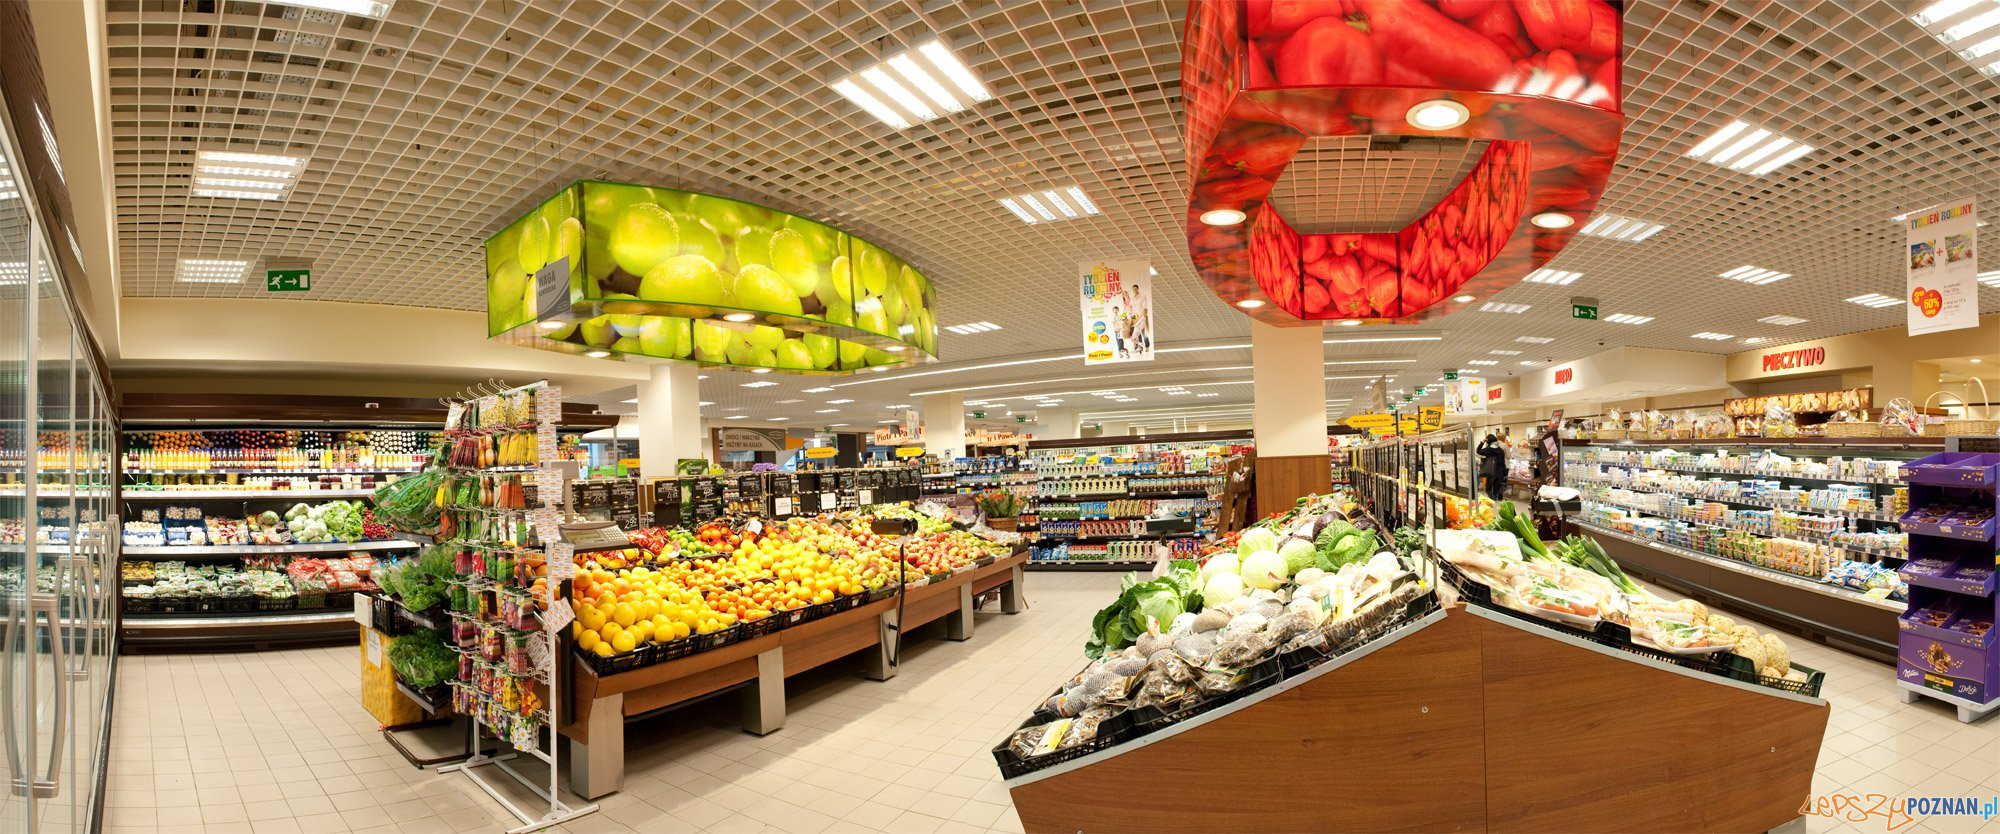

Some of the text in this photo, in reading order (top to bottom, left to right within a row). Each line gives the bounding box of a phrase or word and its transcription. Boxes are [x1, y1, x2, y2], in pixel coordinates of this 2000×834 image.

[1911, 203, 1972, 229] TYDZIEŃ RODZINY
[538, 270, 556, 288] WAGA
[1083, 281, 1121, 296] RODZINY
[1923, 297, 1940, 310] 50%
[1763, 346, 1825, 372] PIECZYWO
[876, 433, 892, 443] Piotr
